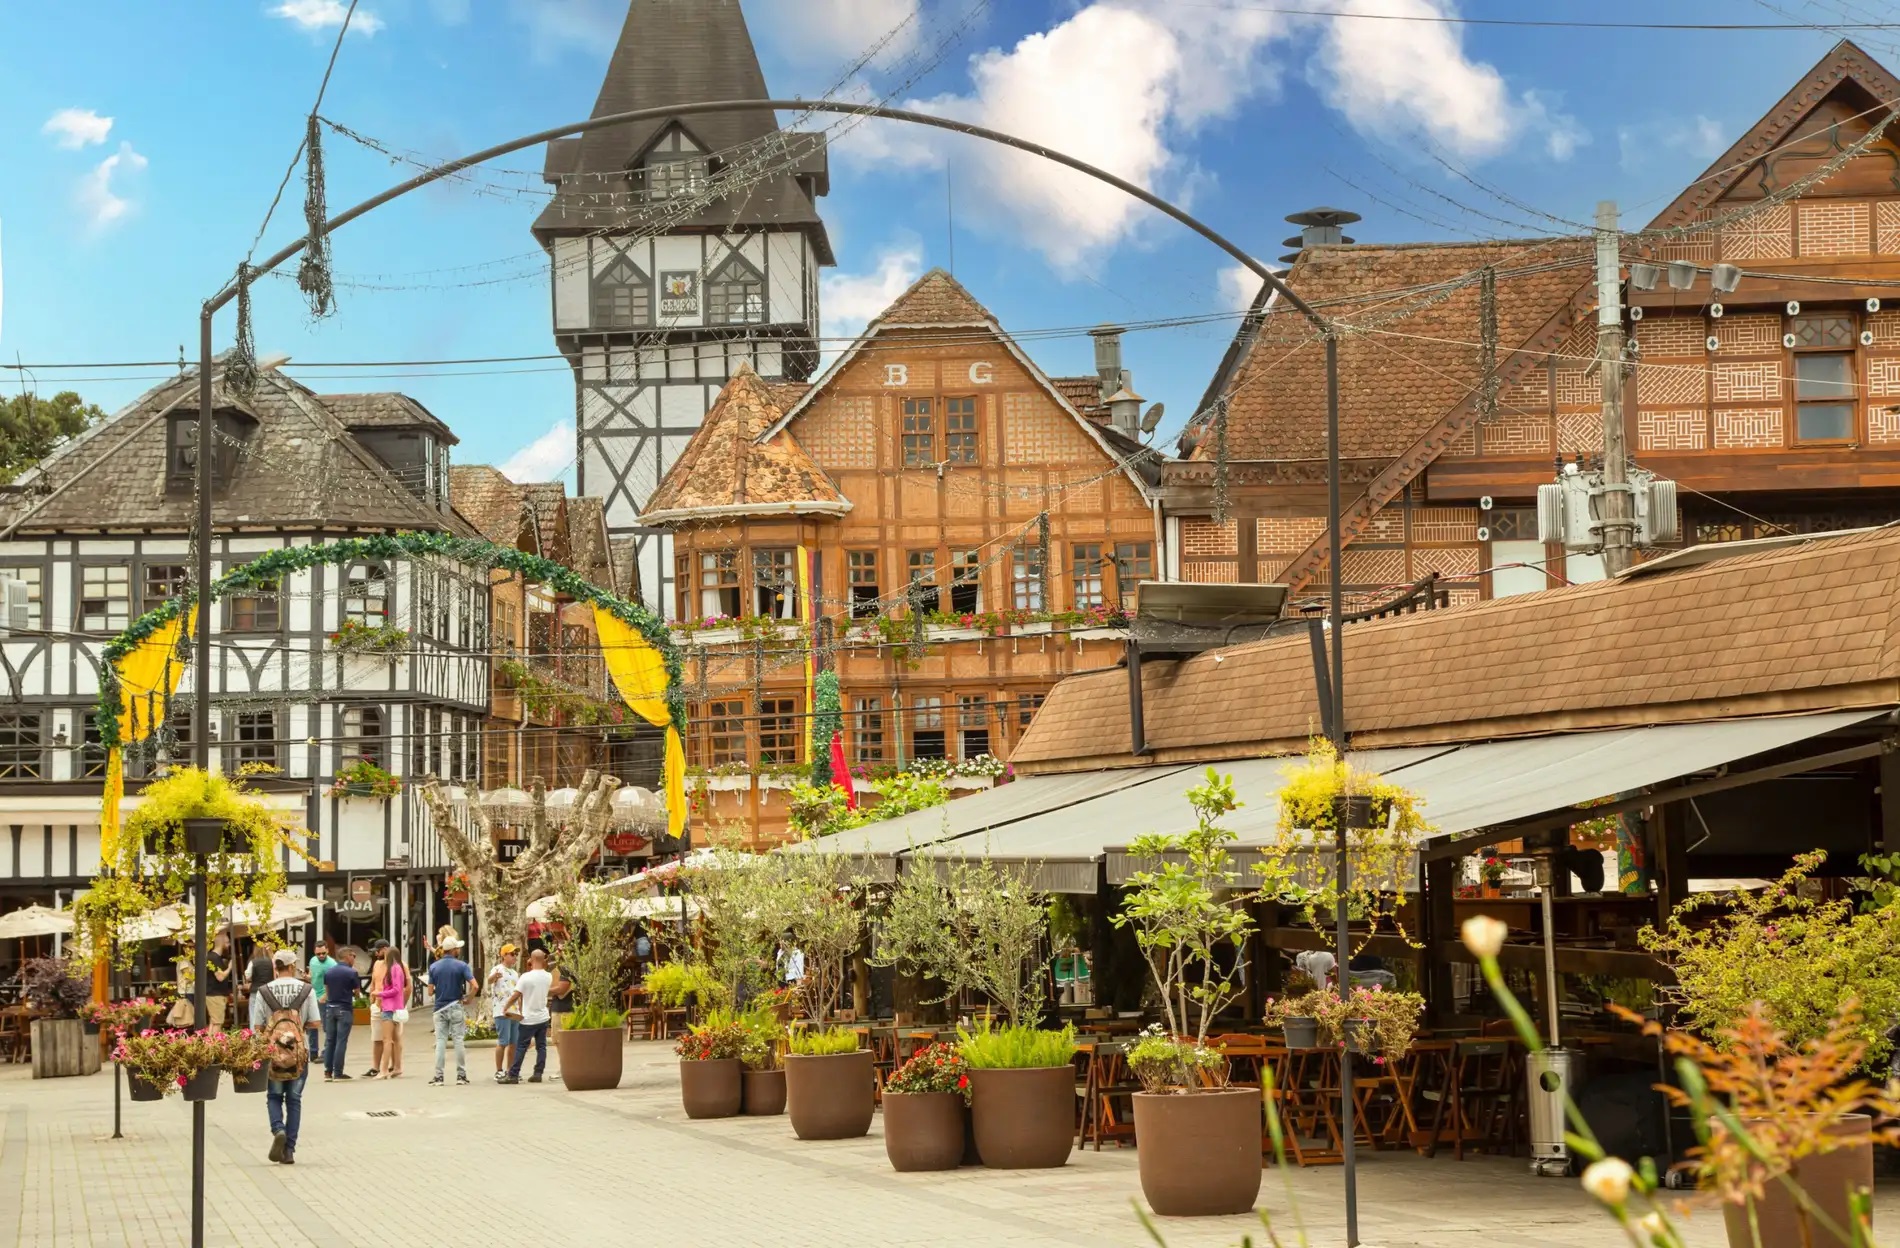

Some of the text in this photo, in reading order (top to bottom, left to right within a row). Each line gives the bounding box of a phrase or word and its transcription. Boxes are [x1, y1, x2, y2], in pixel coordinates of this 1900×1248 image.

[883, 361, 993, 387] B G
[334, 899, 373, 913] LOJA
